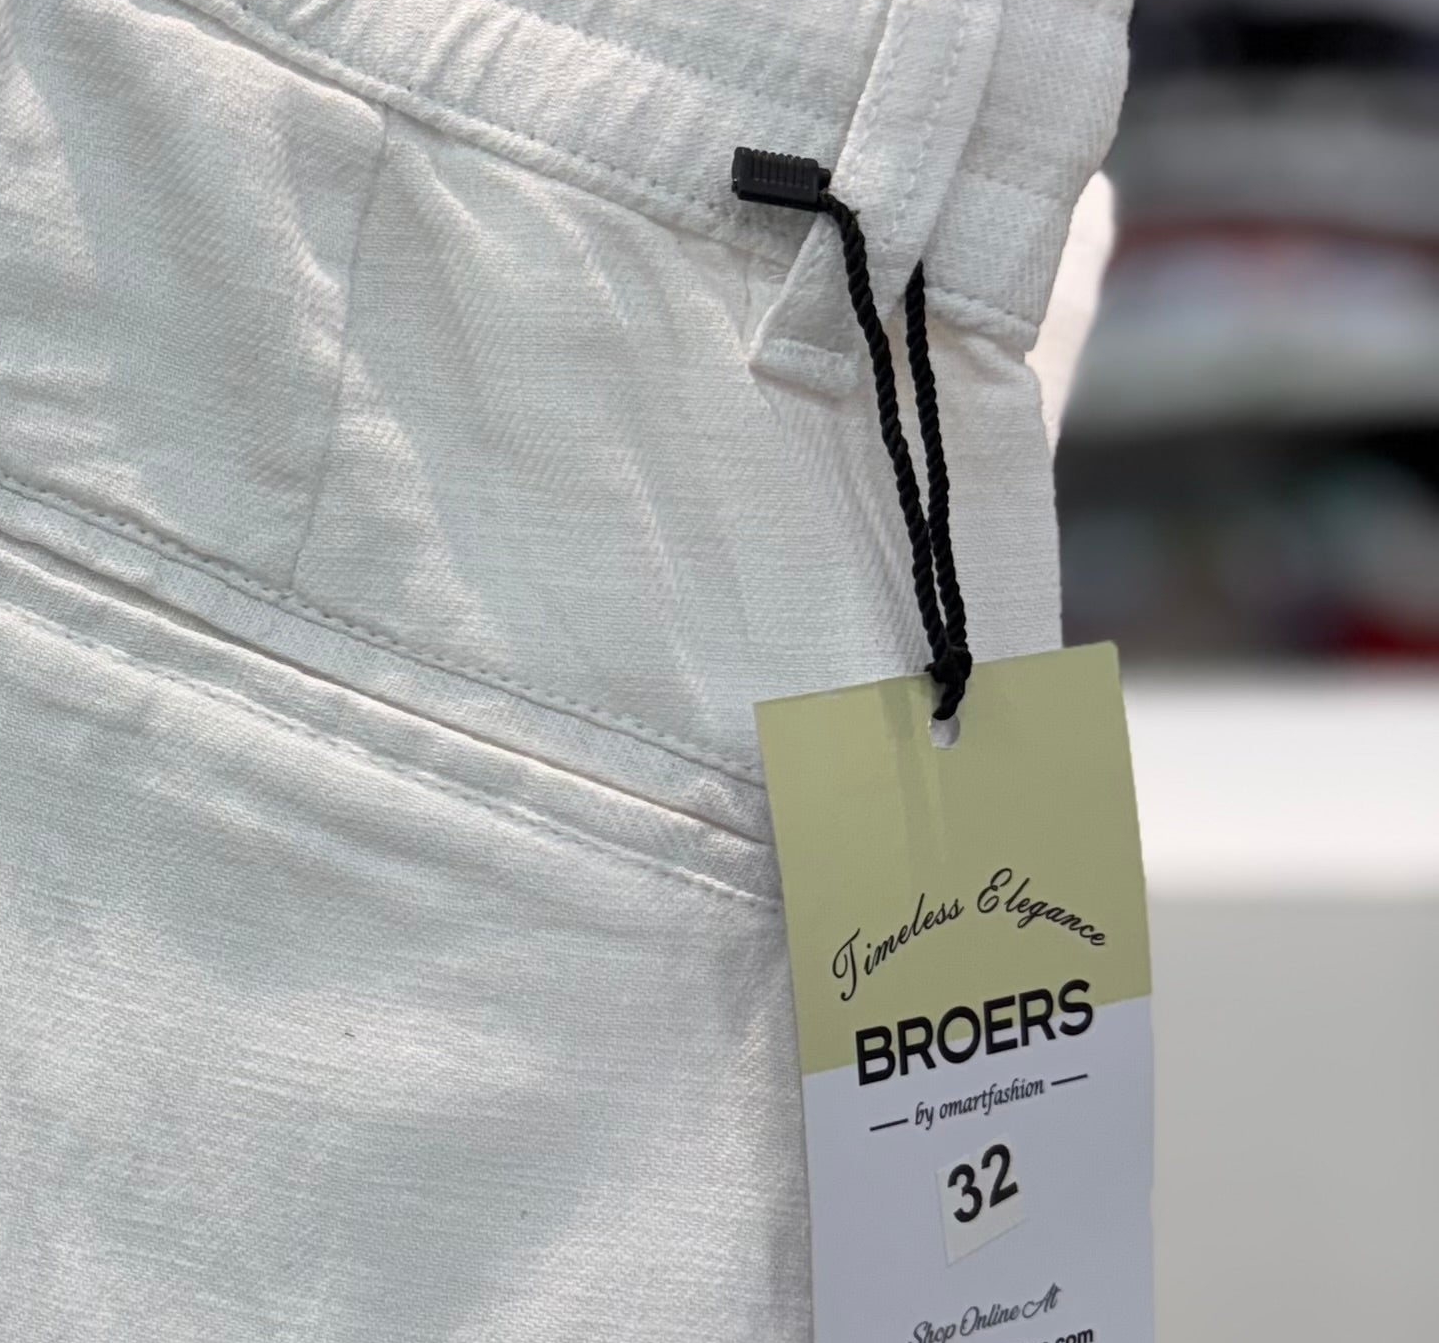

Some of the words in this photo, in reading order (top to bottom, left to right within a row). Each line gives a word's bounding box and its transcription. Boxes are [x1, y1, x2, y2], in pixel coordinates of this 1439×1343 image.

[832, 893, 964, 1001] Timeless
[977, 868, 1106, 946] Elegance
[855, 979, 1094, 1086] BROERS
[914, 1102, 935, 1131] by
[939, 1077, 1045, 1116] omartfashion
[947, 1143, 1019, 1223] 32
[959, 1304, 1020, 1338] Online
[1021, 1282, 1063, 1319] At
